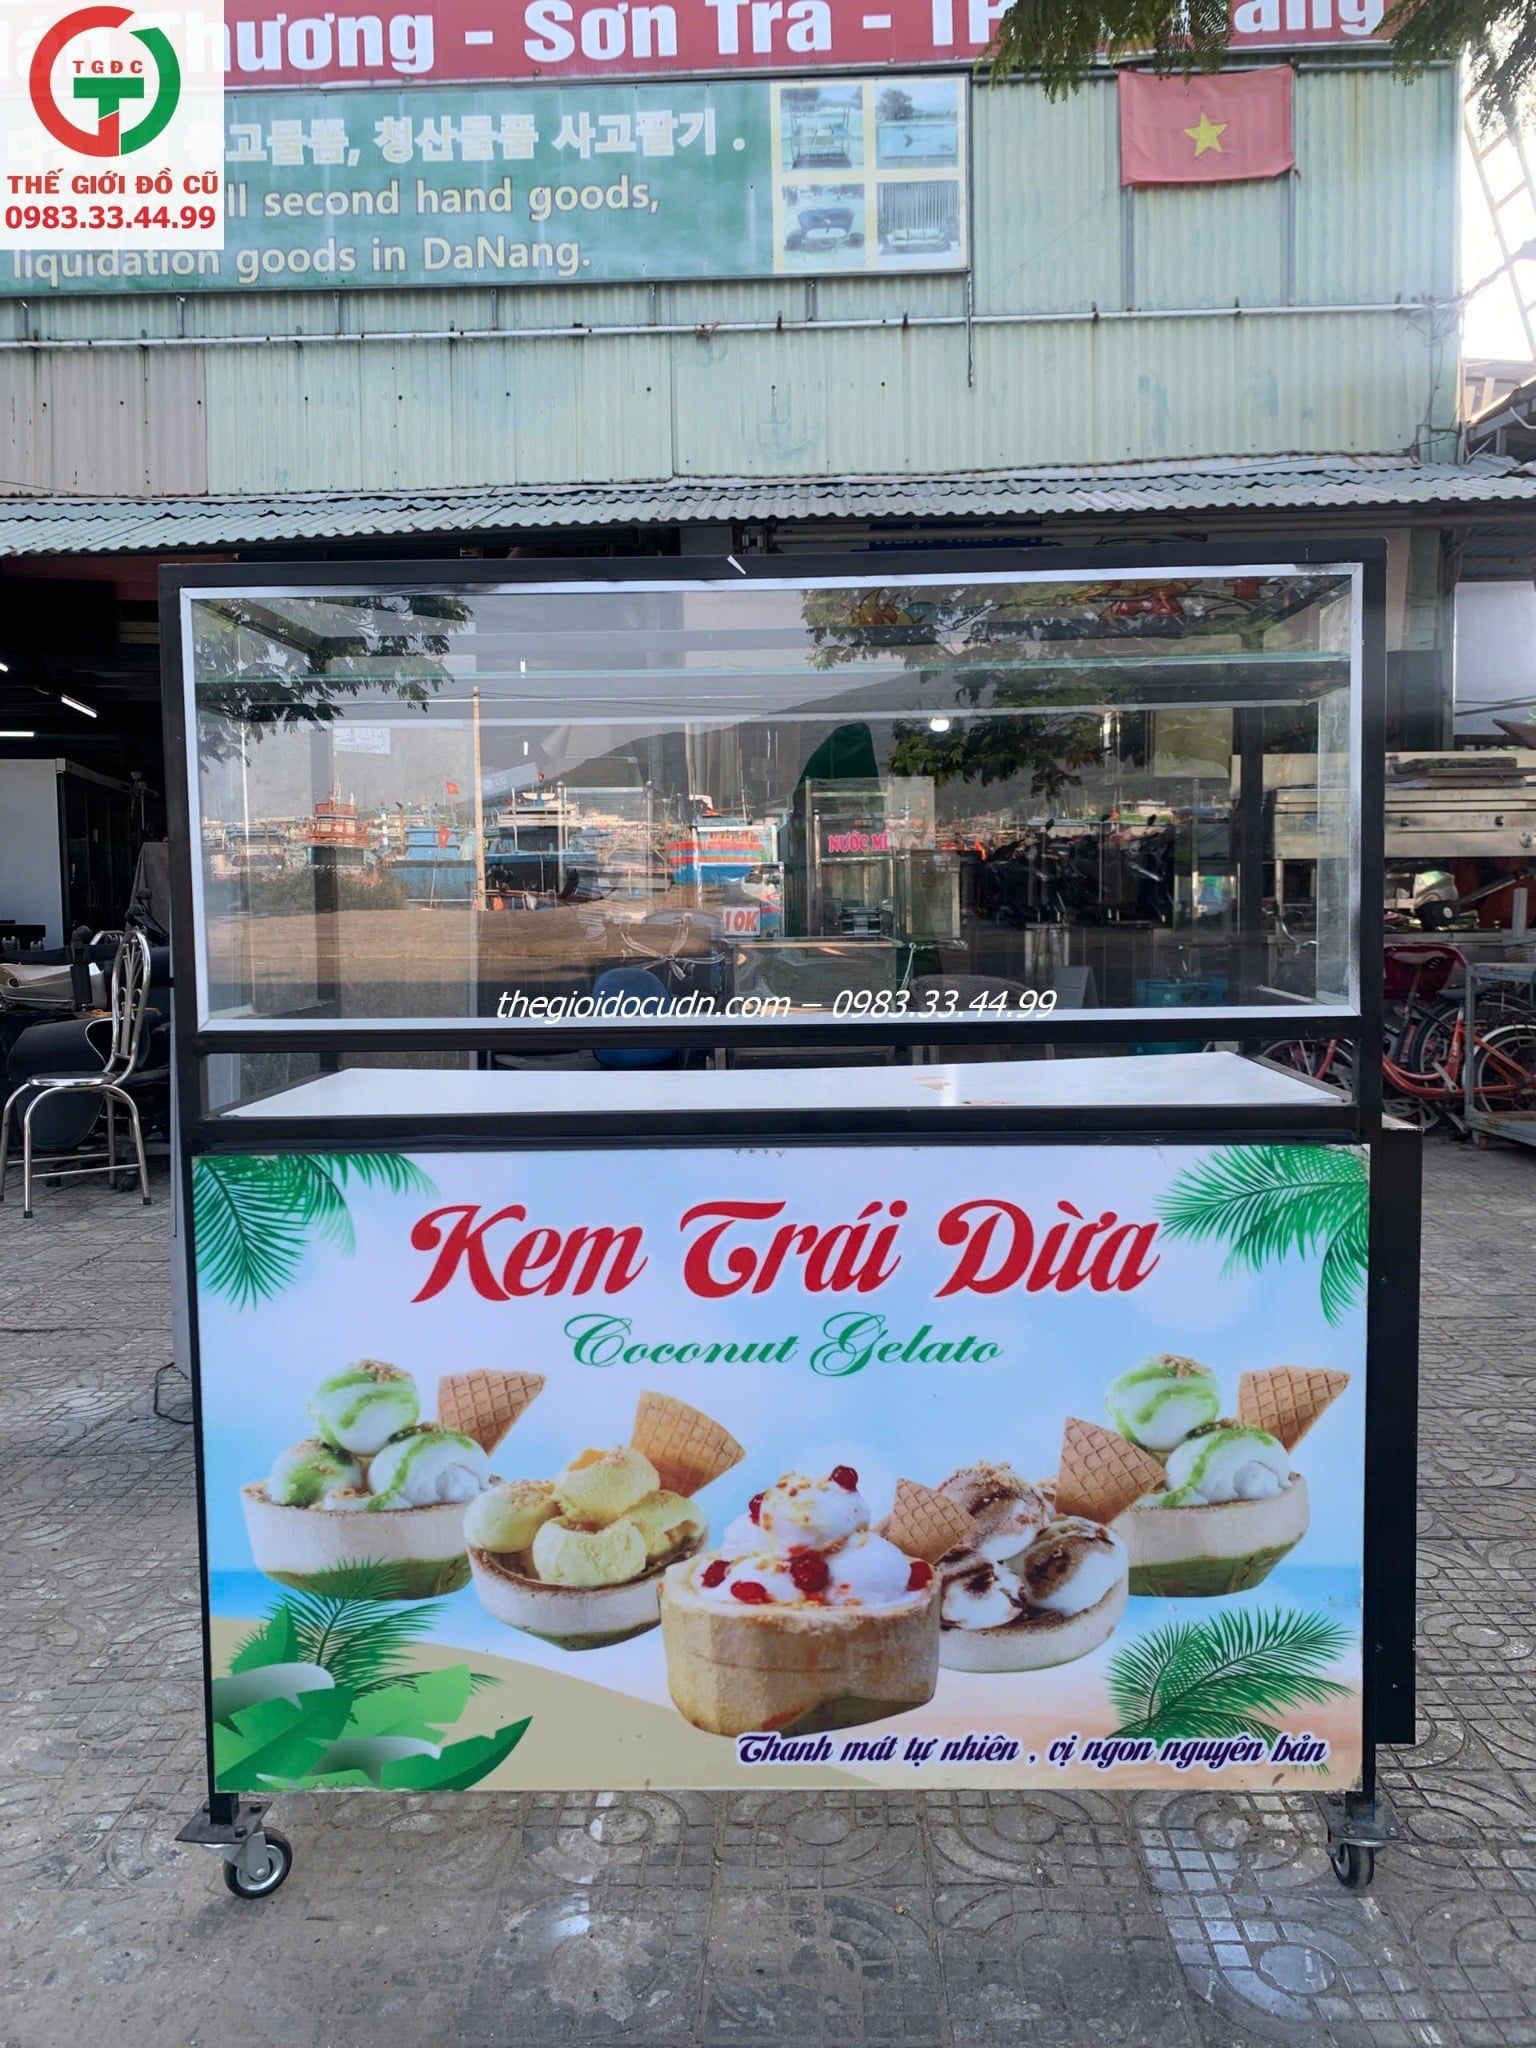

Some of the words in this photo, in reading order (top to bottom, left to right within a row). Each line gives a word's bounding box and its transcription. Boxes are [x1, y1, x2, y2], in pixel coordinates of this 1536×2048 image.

[524, 0, 678, 63] Sơn
[264, 178, 400, 218] second
[416, 176, 513, 215] hand
[529, 173, 660, 223] goods,
[13, 249, 221, 288] liquidation
[236, 236, 357, 285] goods
[371, 237, 407, 272] in
[423, 234, 592, 278] DaNang.
[828, 830, 870, 854] NƯỚC
[724, 909, 759, 932] 10K
[411, 1203, 649, 1304] Kem
[680, 1199, 910, 1300] Trái
[934, 1198, 1162, 1299] Dừa
[564, 1313, 801, 1369] Coconut
[809, 1310, 1005, 1377] Gelato
[738, 1733, 833, 1763] Thanh
[840, 1736, 898, 1762] mát
[903, 1736, 938, 1767] tự
[939, 1734, 1020, 1762] nhiên
[1049, 1735, 1077, 1767] vị
[1081, 1737, 1153, 1769] ngon
[1160, 1734, 1264, 1769] nguyên
[1271, 1734, 1326, 1763] bản
